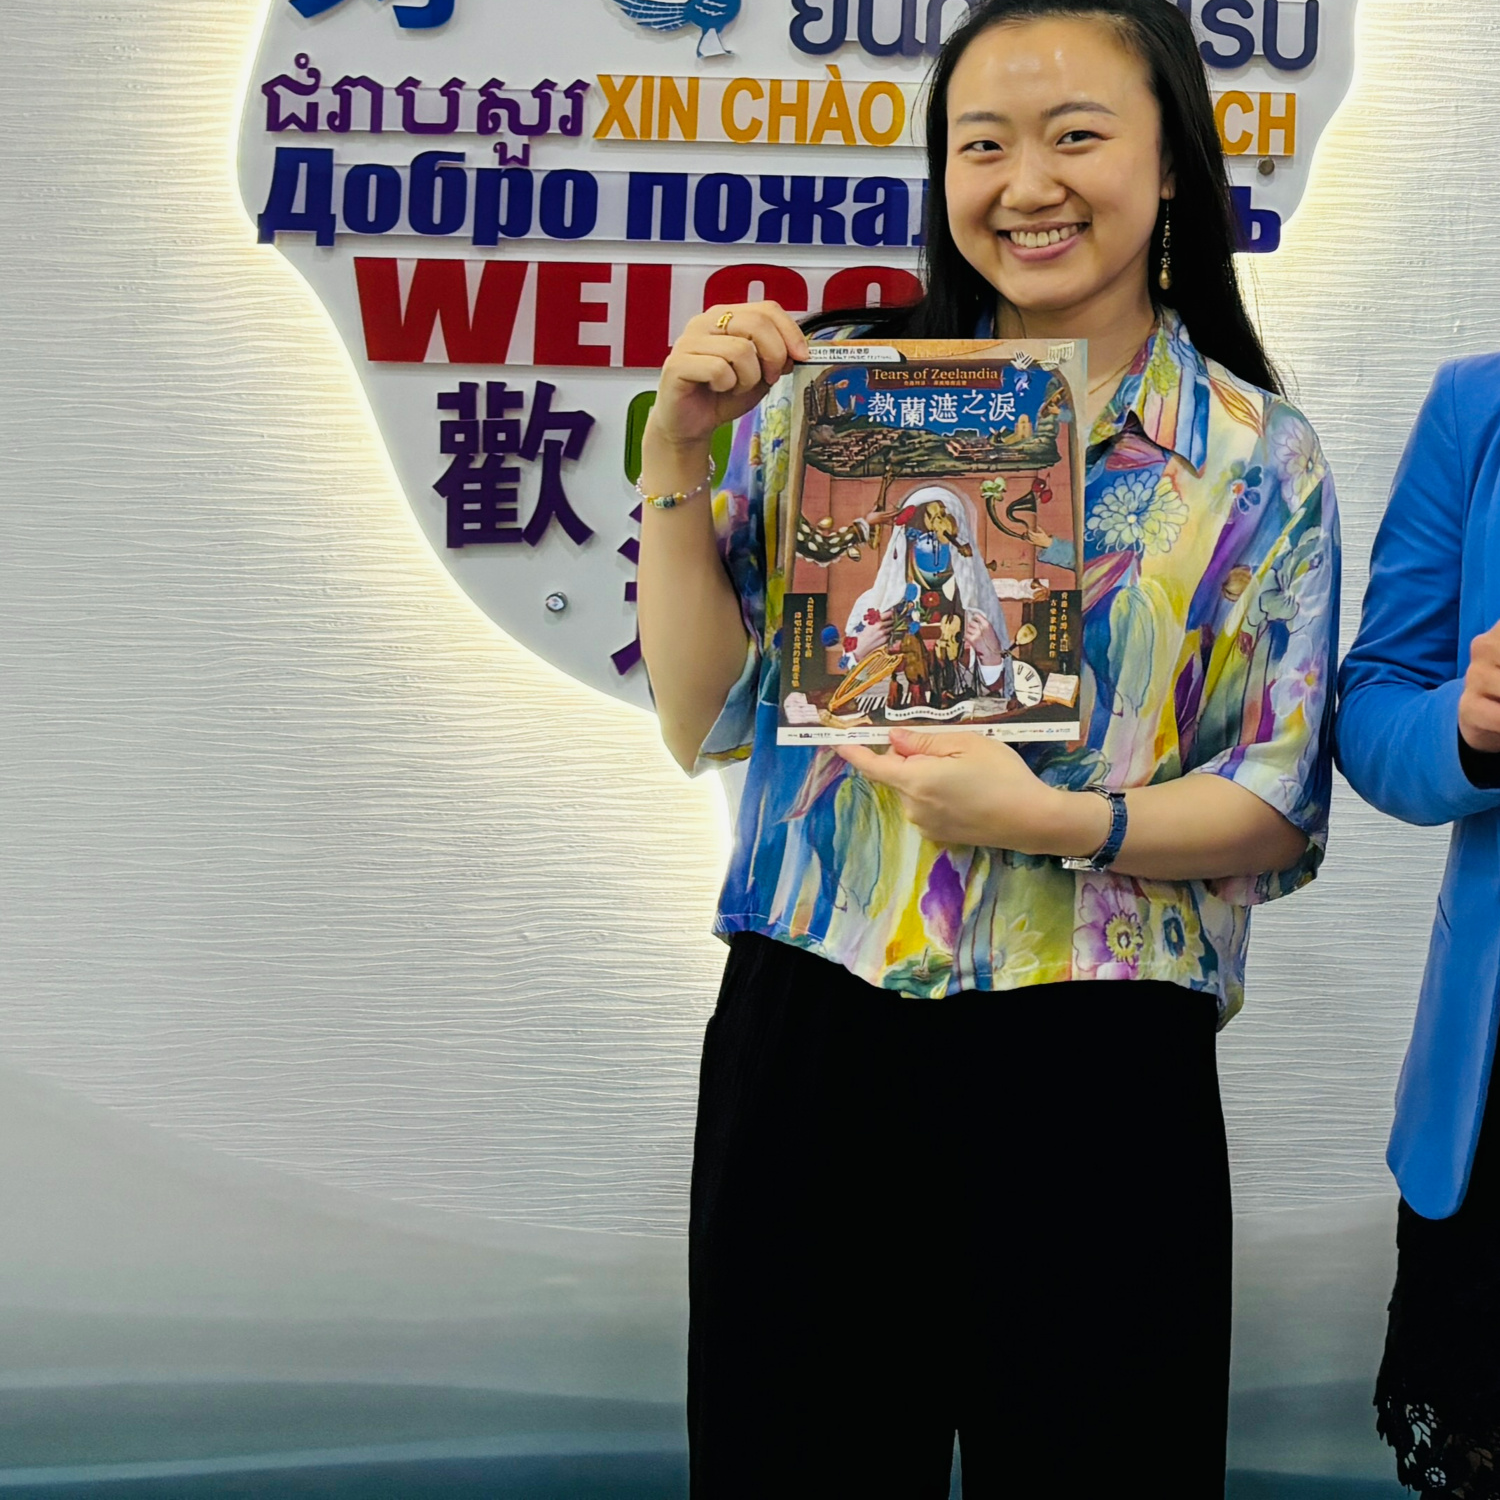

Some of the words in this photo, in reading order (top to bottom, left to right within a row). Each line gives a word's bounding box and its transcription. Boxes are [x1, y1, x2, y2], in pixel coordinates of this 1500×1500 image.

[593, 73, 700, 144] XIN
[720, 64, 906, 148] CHÀO
[257, 145, 599, 247] Добро
[872, 368, 909, 380] Tears
[913, 367, 929, 380] of
[931, 367, 999, 380] Zeelandia
[866, 389, 1016, 428] 熱蘭遮之淚
